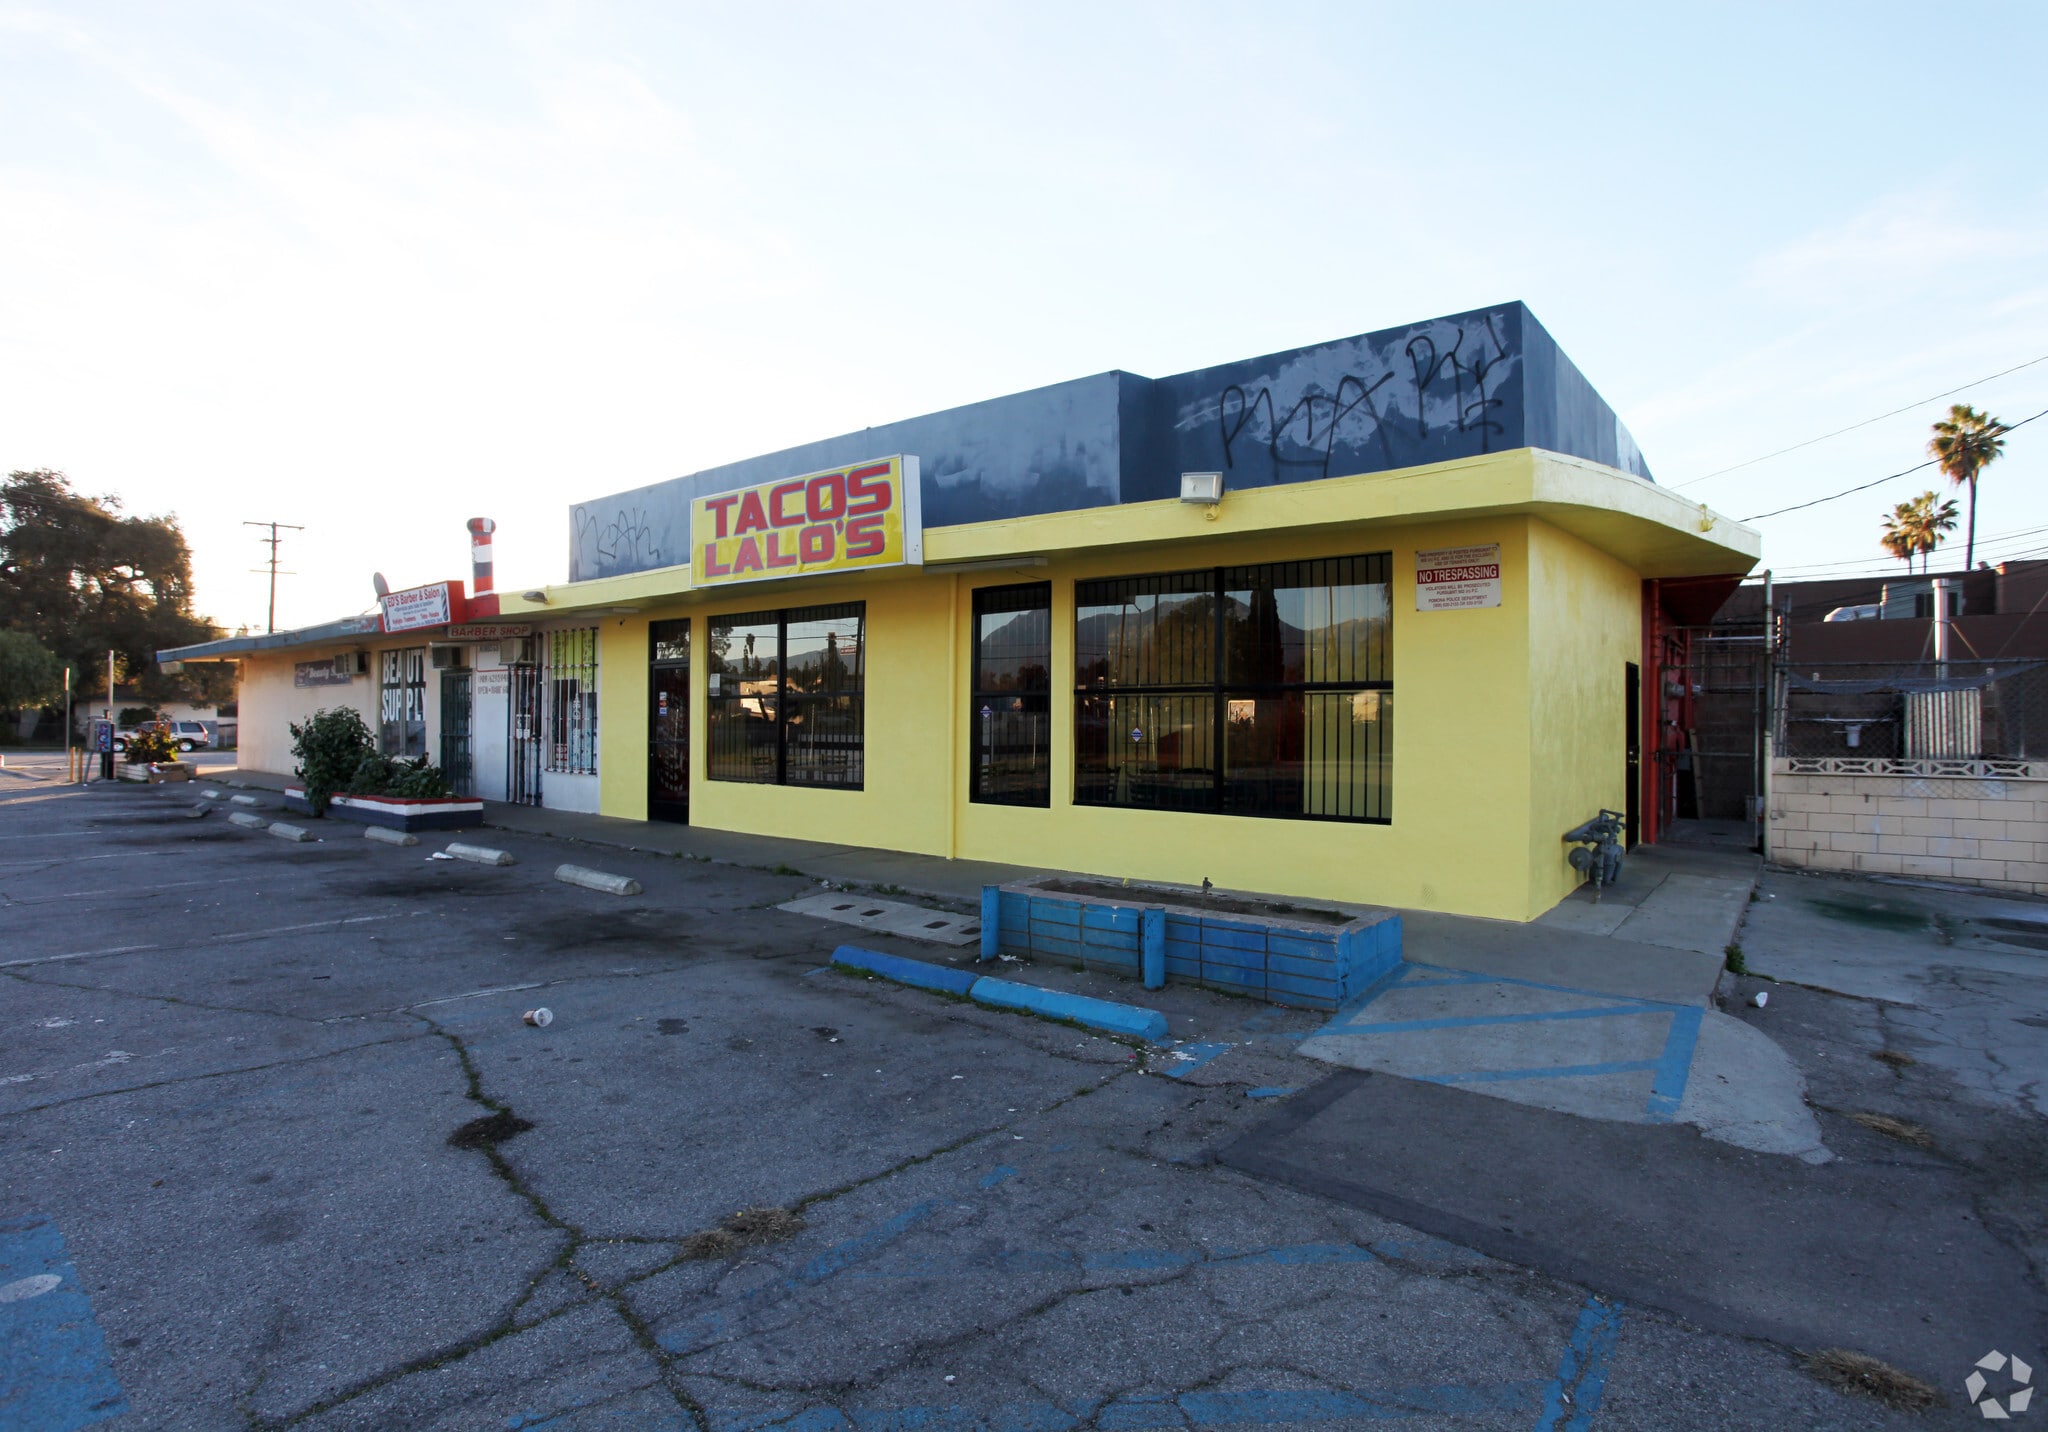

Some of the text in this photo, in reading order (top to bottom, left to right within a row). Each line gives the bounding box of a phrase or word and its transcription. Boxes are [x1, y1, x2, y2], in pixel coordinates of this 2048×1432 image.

[705, 462, 892, 539] TACOS
[704, 513, 885, 578] LALO'S
[1419, 566, 1497, 582] NO TRESPASSING
[387, 595, 400, 607] ED'S
[400, 593, 418, 604] Barber
[419, 590, 423, 600] &
[424, 588, 440, 599] Salon
[451, 626, 528, 636] BARBER SHOP
[382, 687, 426, 721] SUPPLY
